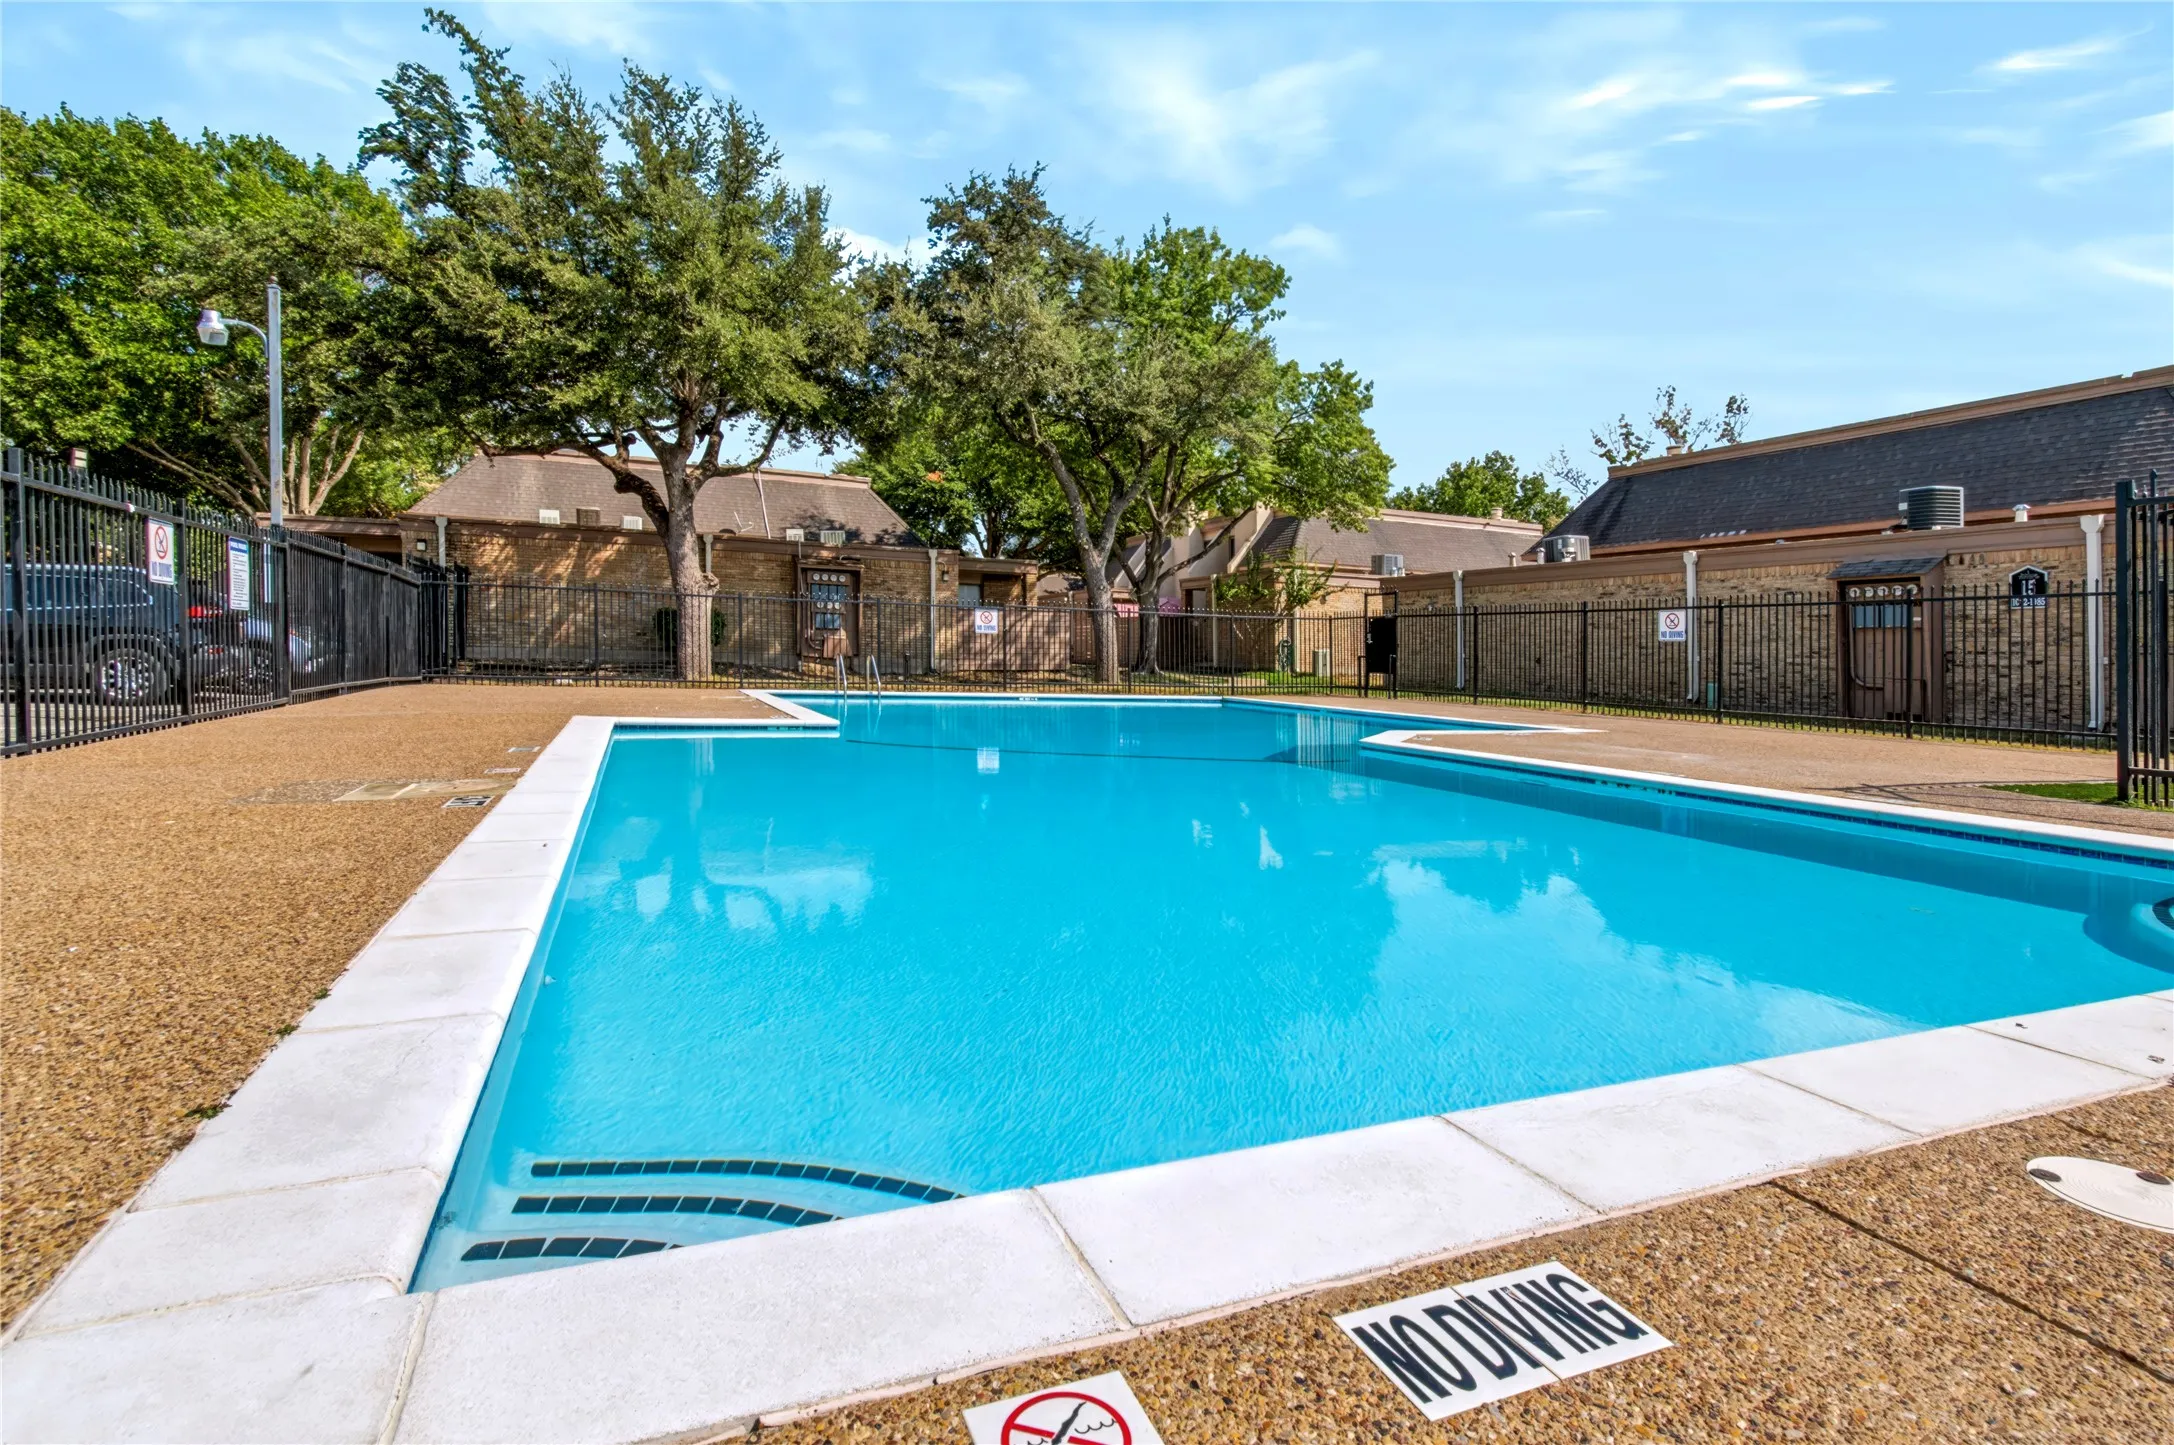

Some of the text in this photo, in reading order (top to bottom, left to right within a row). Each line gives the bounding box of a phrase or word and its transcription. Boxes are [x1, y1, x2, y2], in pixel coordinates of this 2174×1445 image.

[151, 561, 172, 578] NO DIVING
[2021, 579, 2036, 596] 15
[1661, 630, 1683, 638] NO DIVING
[1351, 1273, 1649, 1402] NO DIVING
